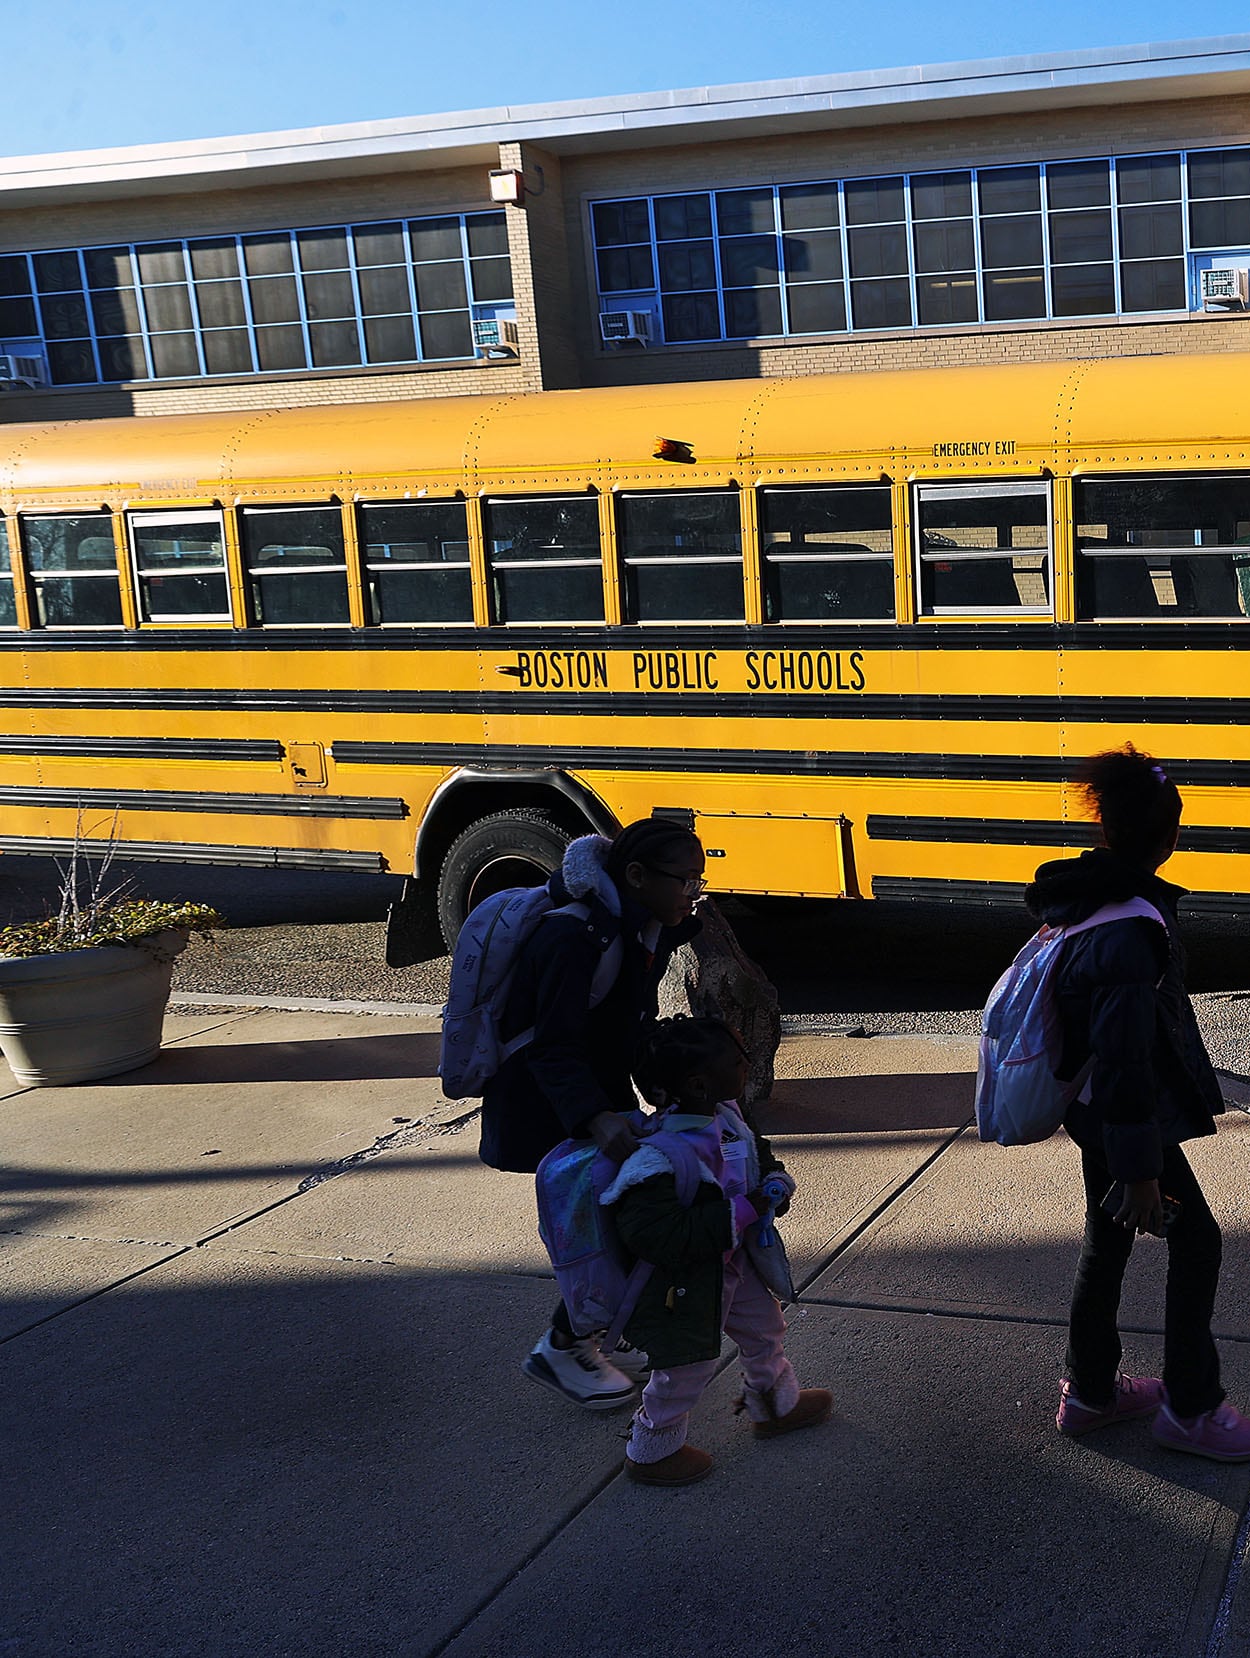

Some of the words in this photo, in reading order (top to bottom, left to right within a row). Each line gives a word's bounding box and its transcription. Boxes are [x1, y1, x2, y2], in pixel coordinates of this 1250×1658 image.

[933, 442, 990, 457] EMERGENCY
[995, 440, 1016, 455] EXIT
[519, 651, 608, 688] BOSTON
[633, 652, 719, 689] PUBLIC
[745, 652, 866, 691] SCHOOLS
